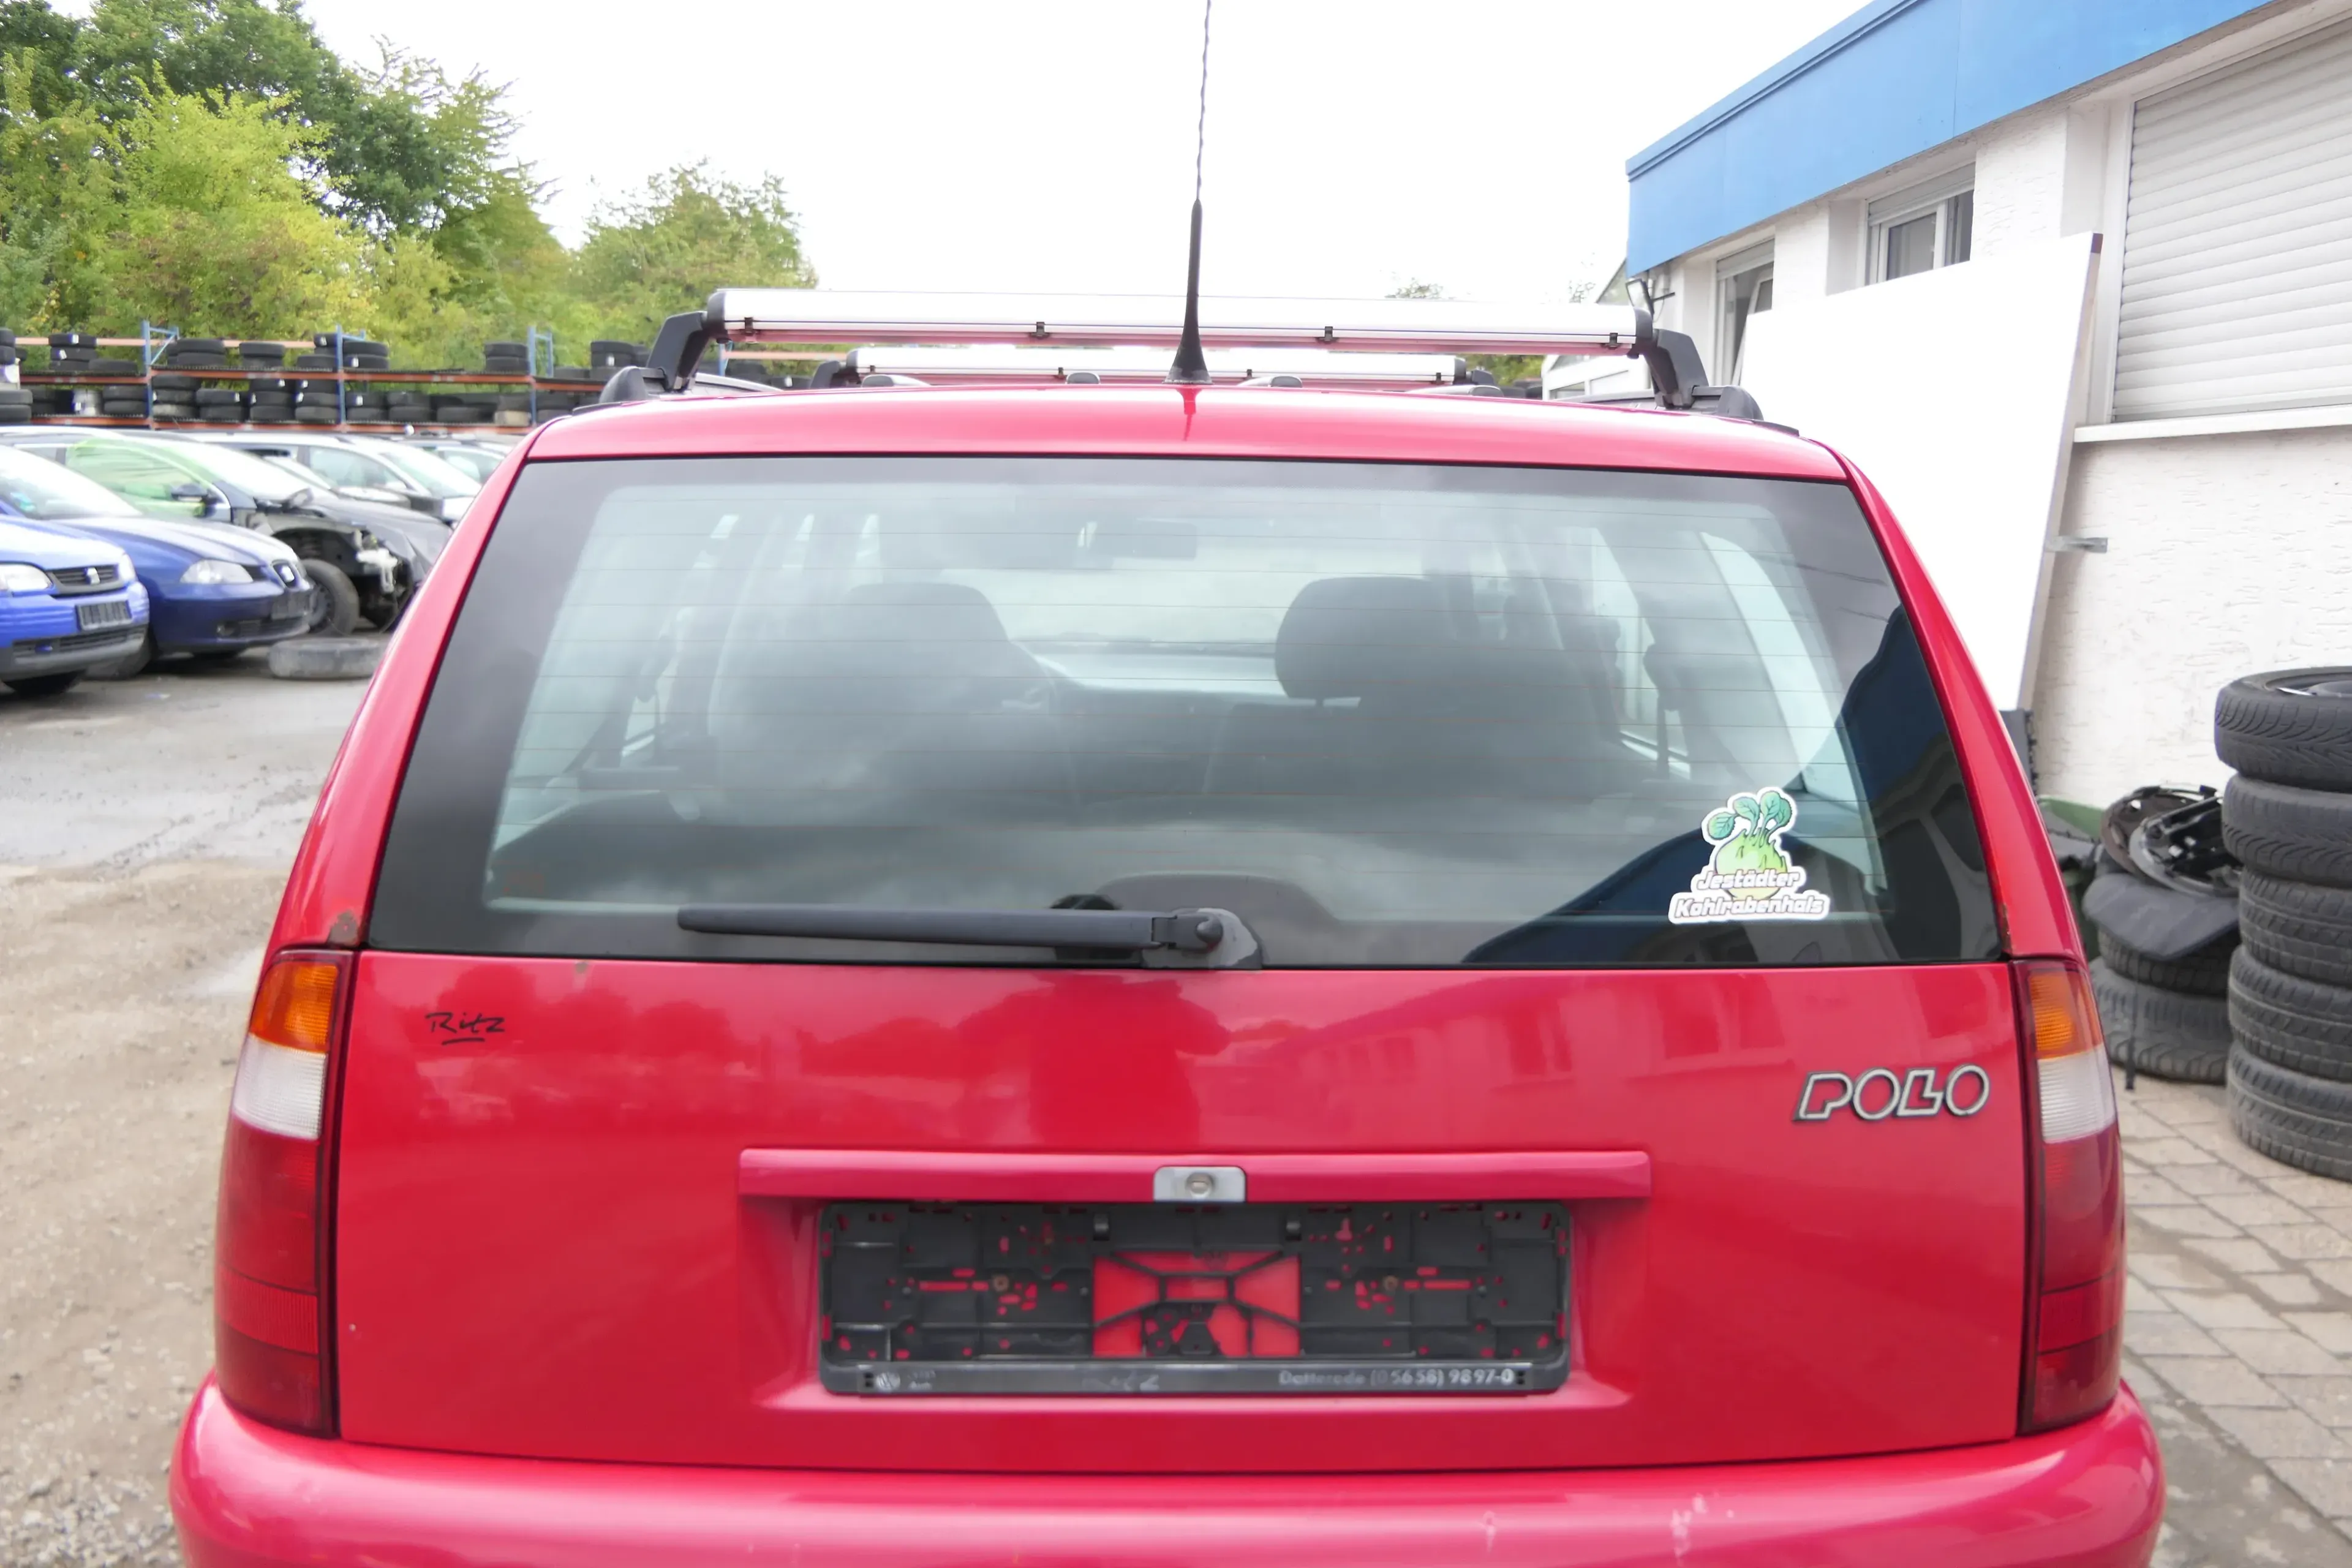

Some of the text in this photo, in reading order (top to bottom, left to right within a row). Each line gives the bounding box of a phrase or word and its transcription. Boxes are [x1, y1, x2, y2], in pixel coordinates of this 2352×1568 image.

[1696, 869, 1800, 891] Jestädter
[1673, 895, 1825, 918] Kohlrabenhals
[1792, 1063, 1991, 1121] POLO
